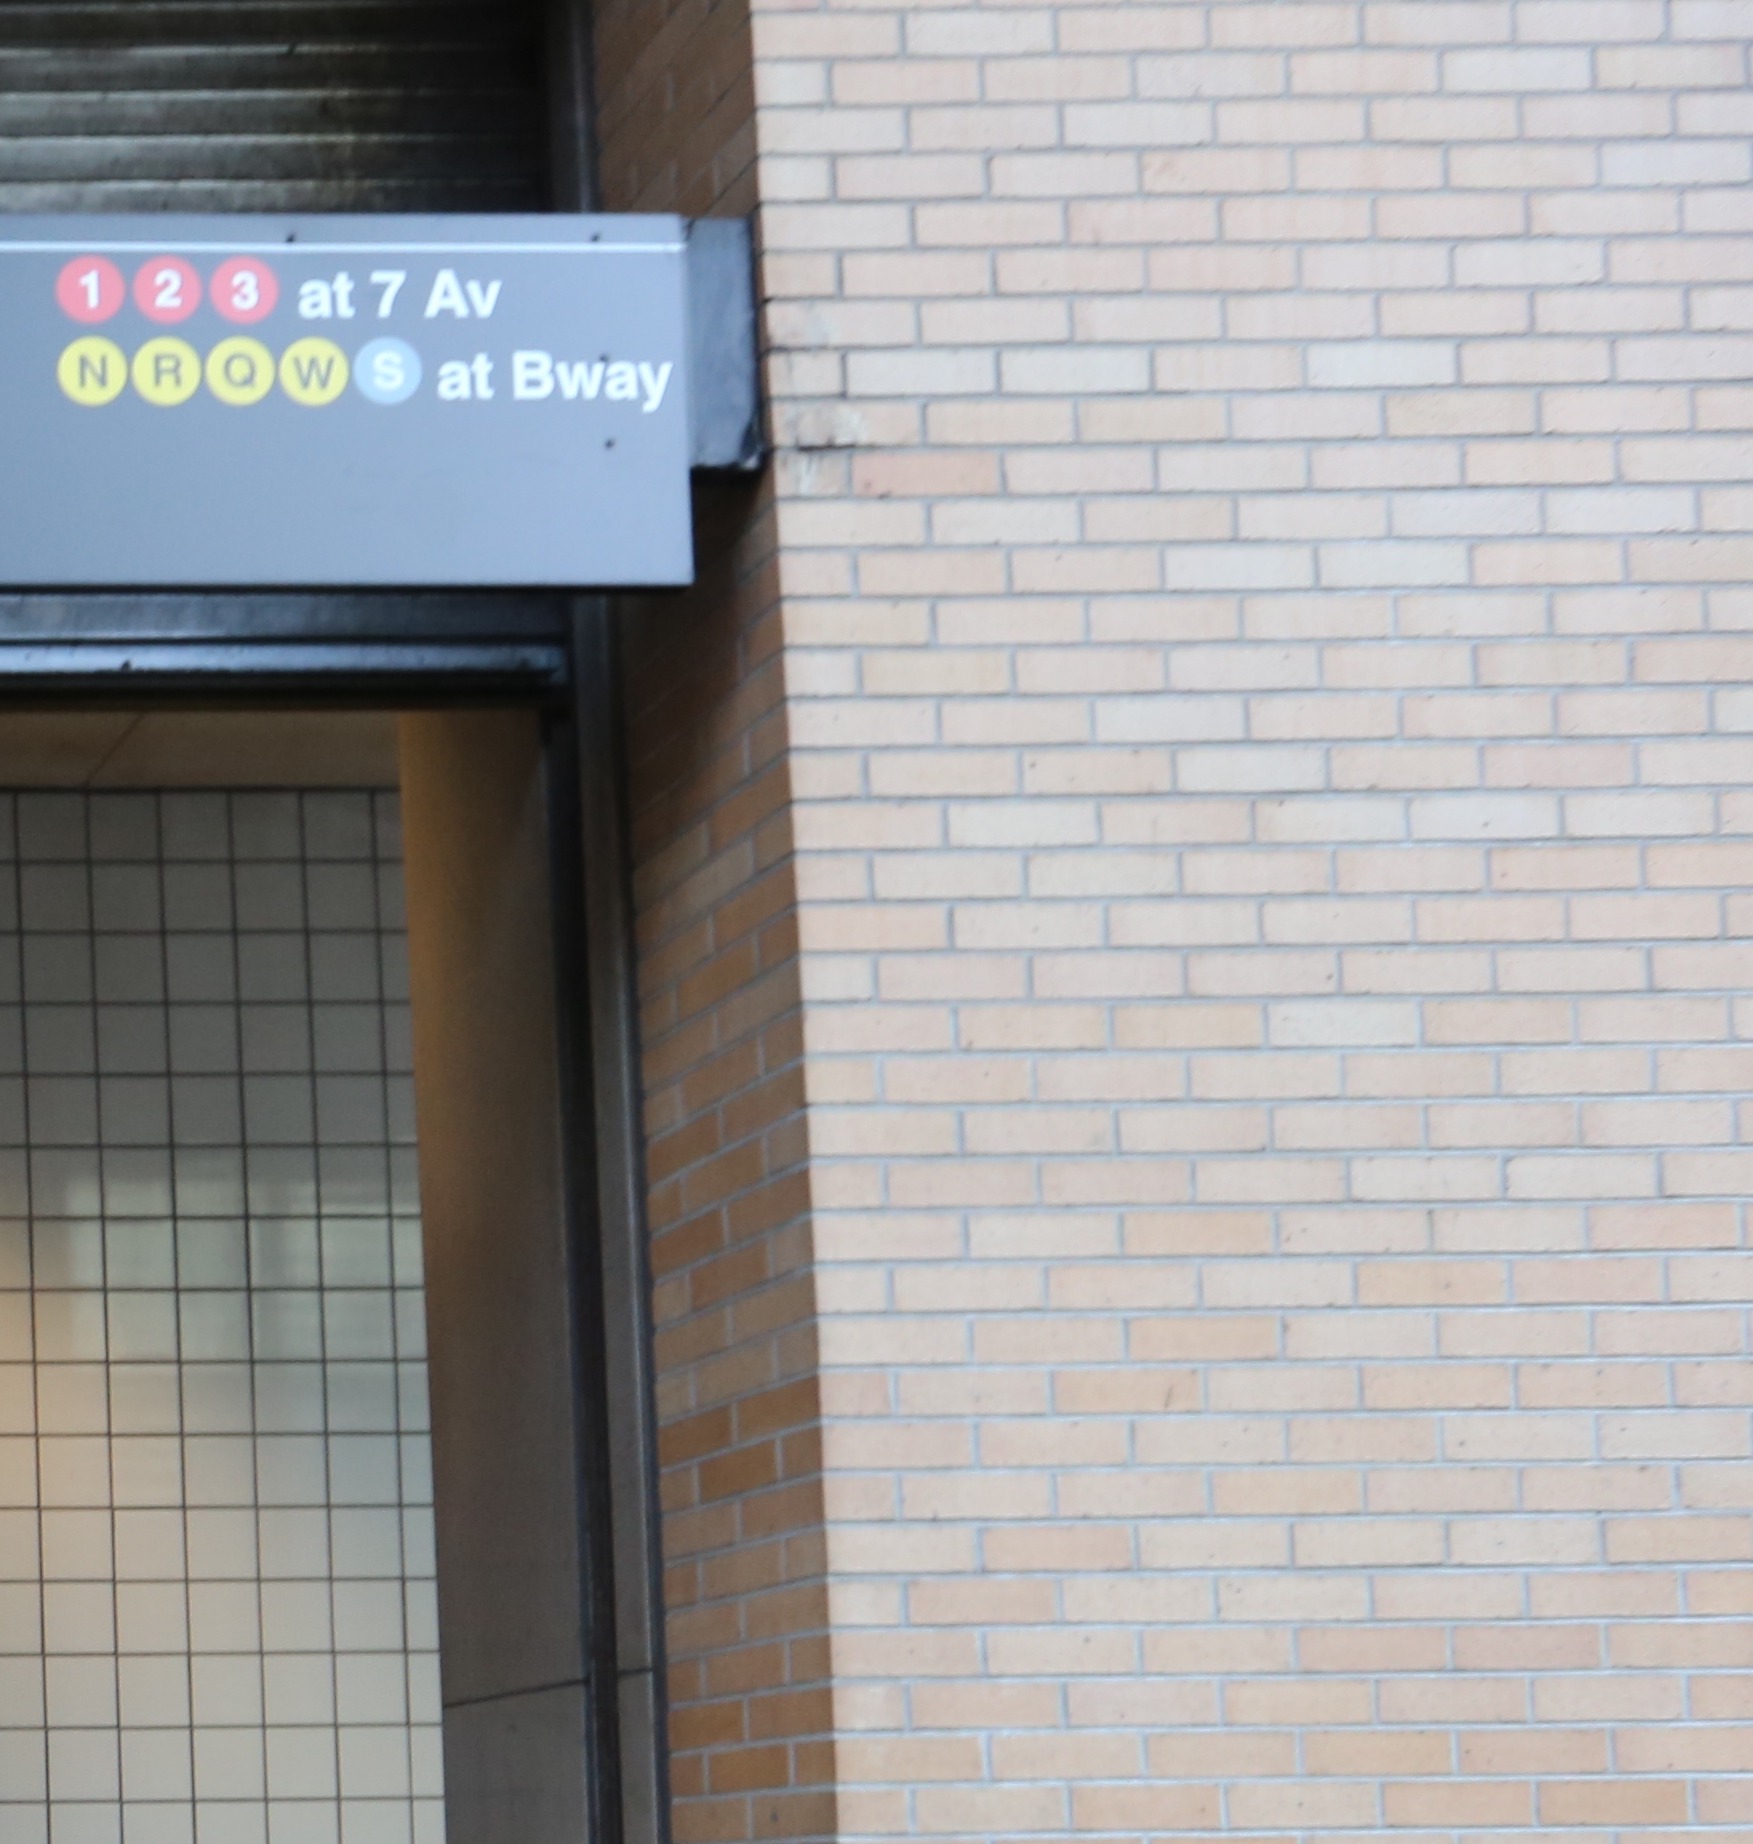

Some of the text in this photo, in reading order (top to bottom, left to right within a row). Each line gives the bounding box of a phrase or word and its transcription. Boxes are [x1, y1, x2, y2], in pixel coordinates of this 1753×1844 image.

[79, 270, 502, 319] 1 2 3 at 7 Av
[78, 349, 674, 414] N R Q W S at Bway
